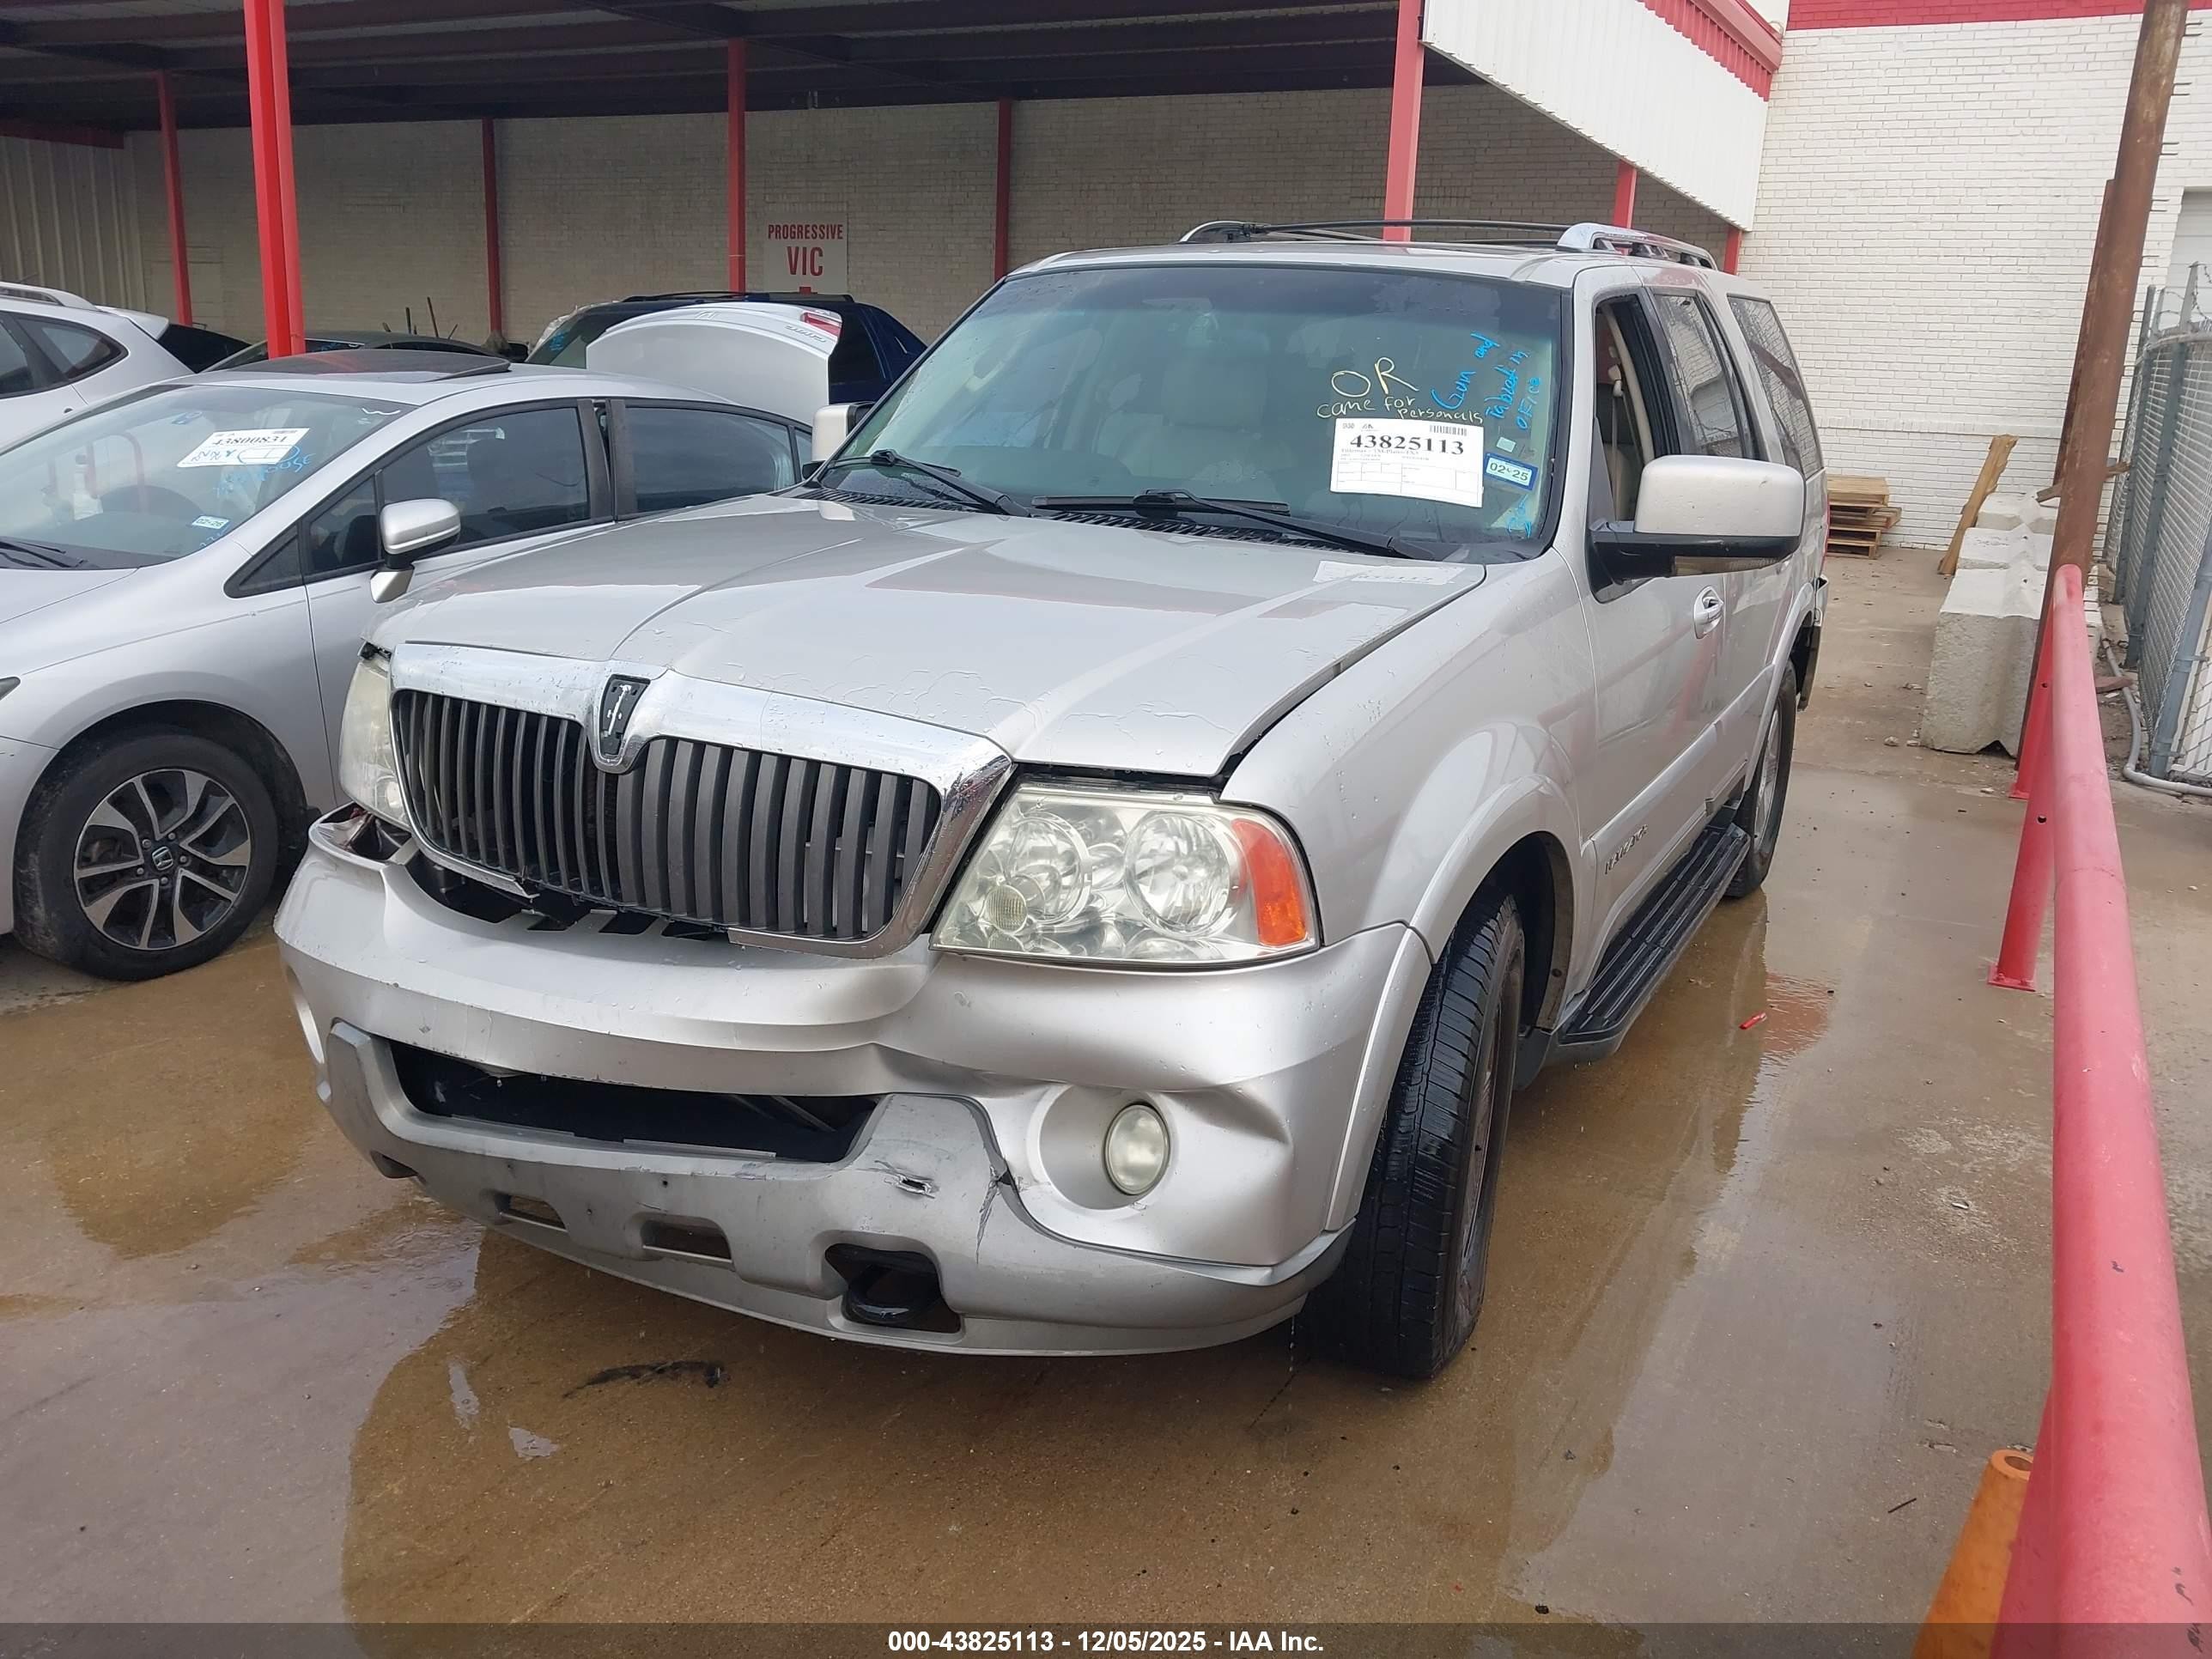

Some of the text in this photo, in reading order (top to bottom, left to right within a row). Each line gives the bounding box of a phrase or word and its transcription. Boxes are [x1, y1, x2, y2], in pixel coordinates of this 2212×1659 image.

[768, 224, 843, 240] PROGRESSIVE
[787, 246, 824, 276] VIC
[1331, 356, 1419, 398] OR
[1350, 434, 1464, 455] 43825113
